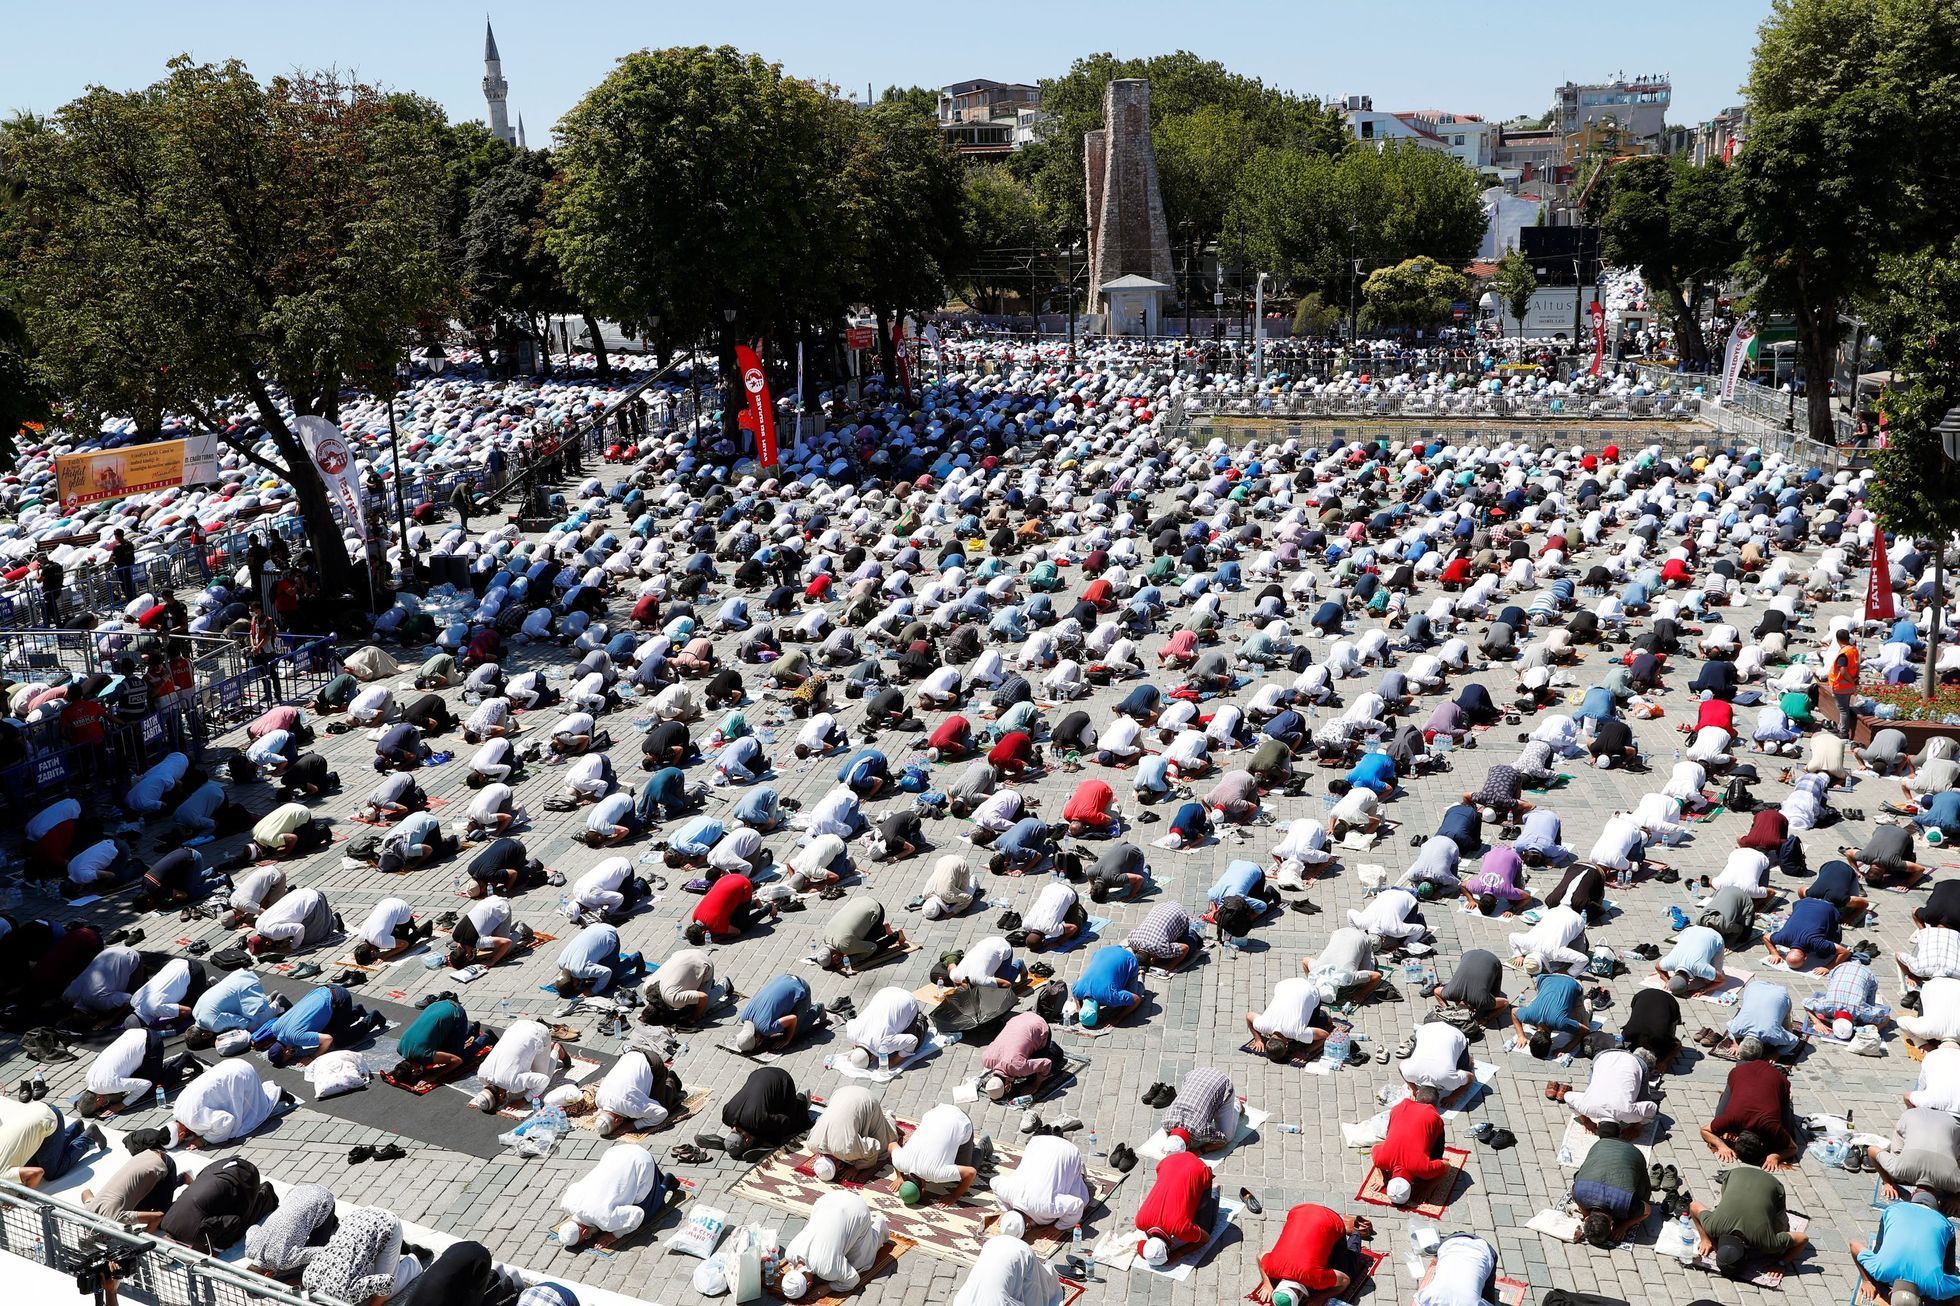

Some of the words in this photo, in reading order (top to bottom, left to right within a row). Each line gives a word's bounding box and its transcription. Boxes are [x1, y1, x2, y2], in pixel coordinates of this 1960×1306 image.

[1533, 299, 1573, 311] Altus
[84, 491, 112, 500] FATİH
[143, 714, 159, 730] FATİH
[142, 725, 163, 741] ZABITA
[38, 757, 60, 771] FATİH
[37, 767, 65, 783] ZABITA
